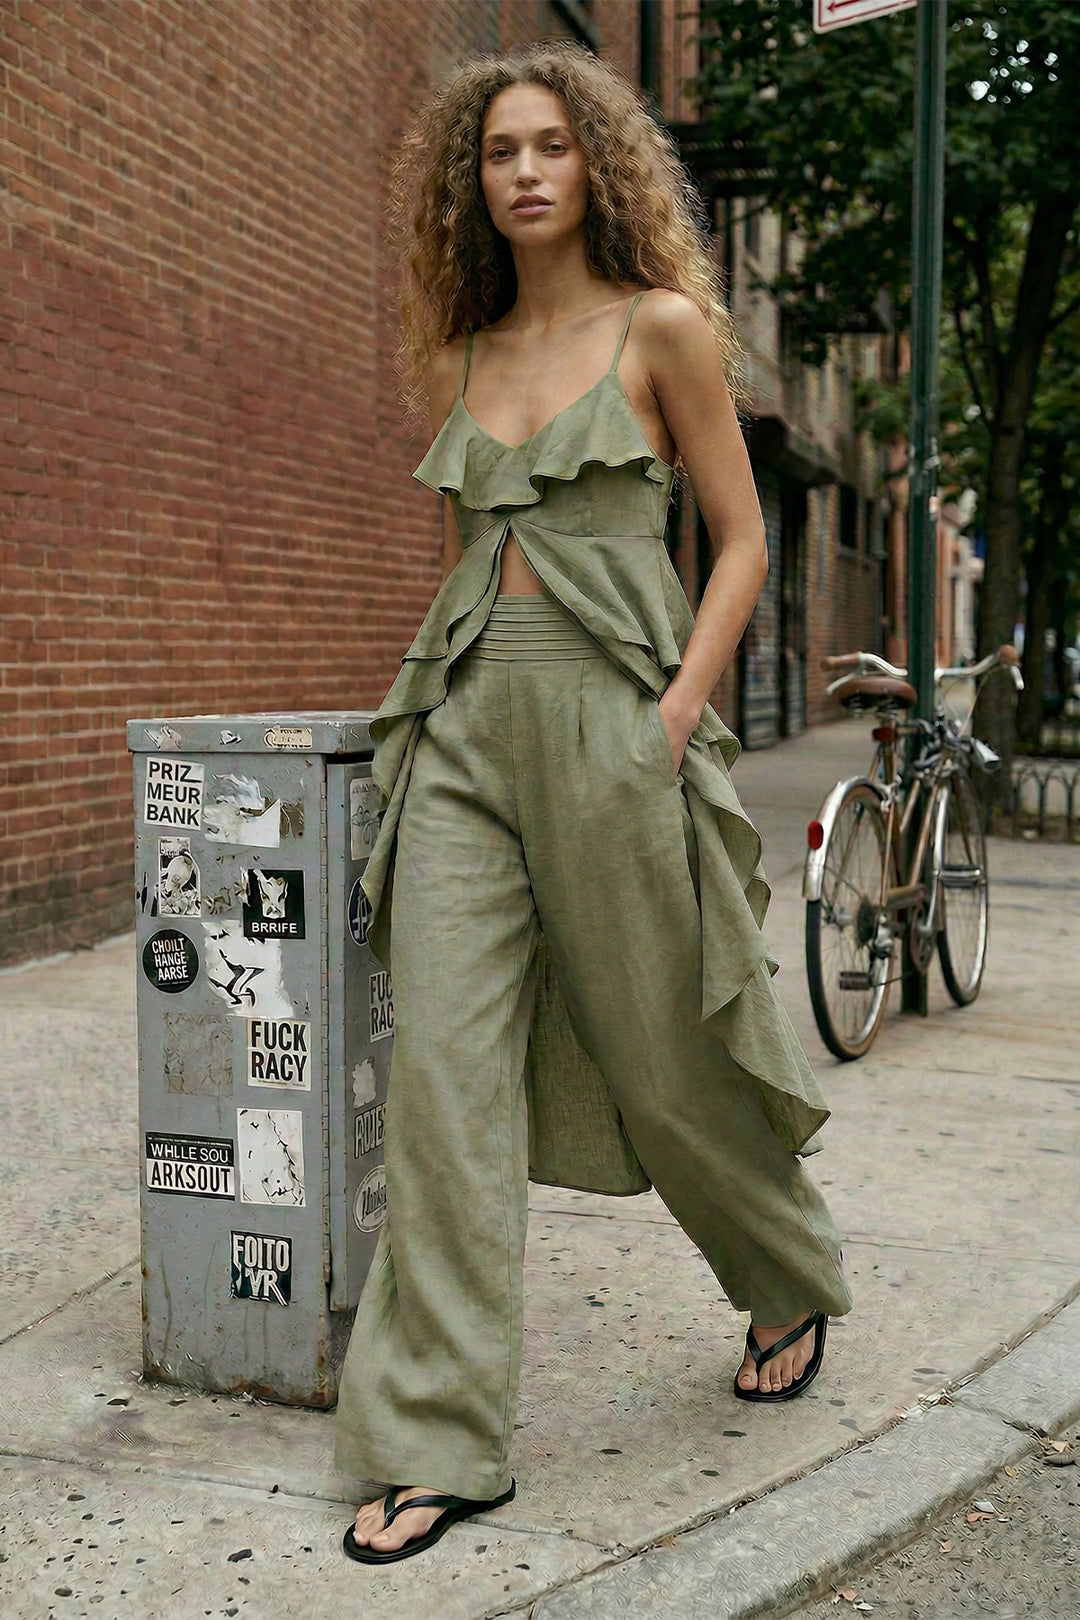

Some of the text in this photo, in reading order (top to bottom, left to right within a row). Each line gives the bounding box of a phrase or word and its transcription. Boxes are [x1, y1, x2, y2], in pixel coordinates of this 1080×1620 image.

[149, 761, 202, 783] PRIZ
[147, 782, 201, 805] MEUR
[147, 804, 200, 827] BANK
[251, 922, 298, 934] BRRIFE
[154, 952, 188, 968] HANGE
[158, 965, 189, 981] AARSE
[251, 1020, 307, 1052] FUCK
[251, 1051, 307, 1082] RACY
[199, 1147, 229, 1163] SOU
[151, 1161, 231, 1193] ARKSOUT
